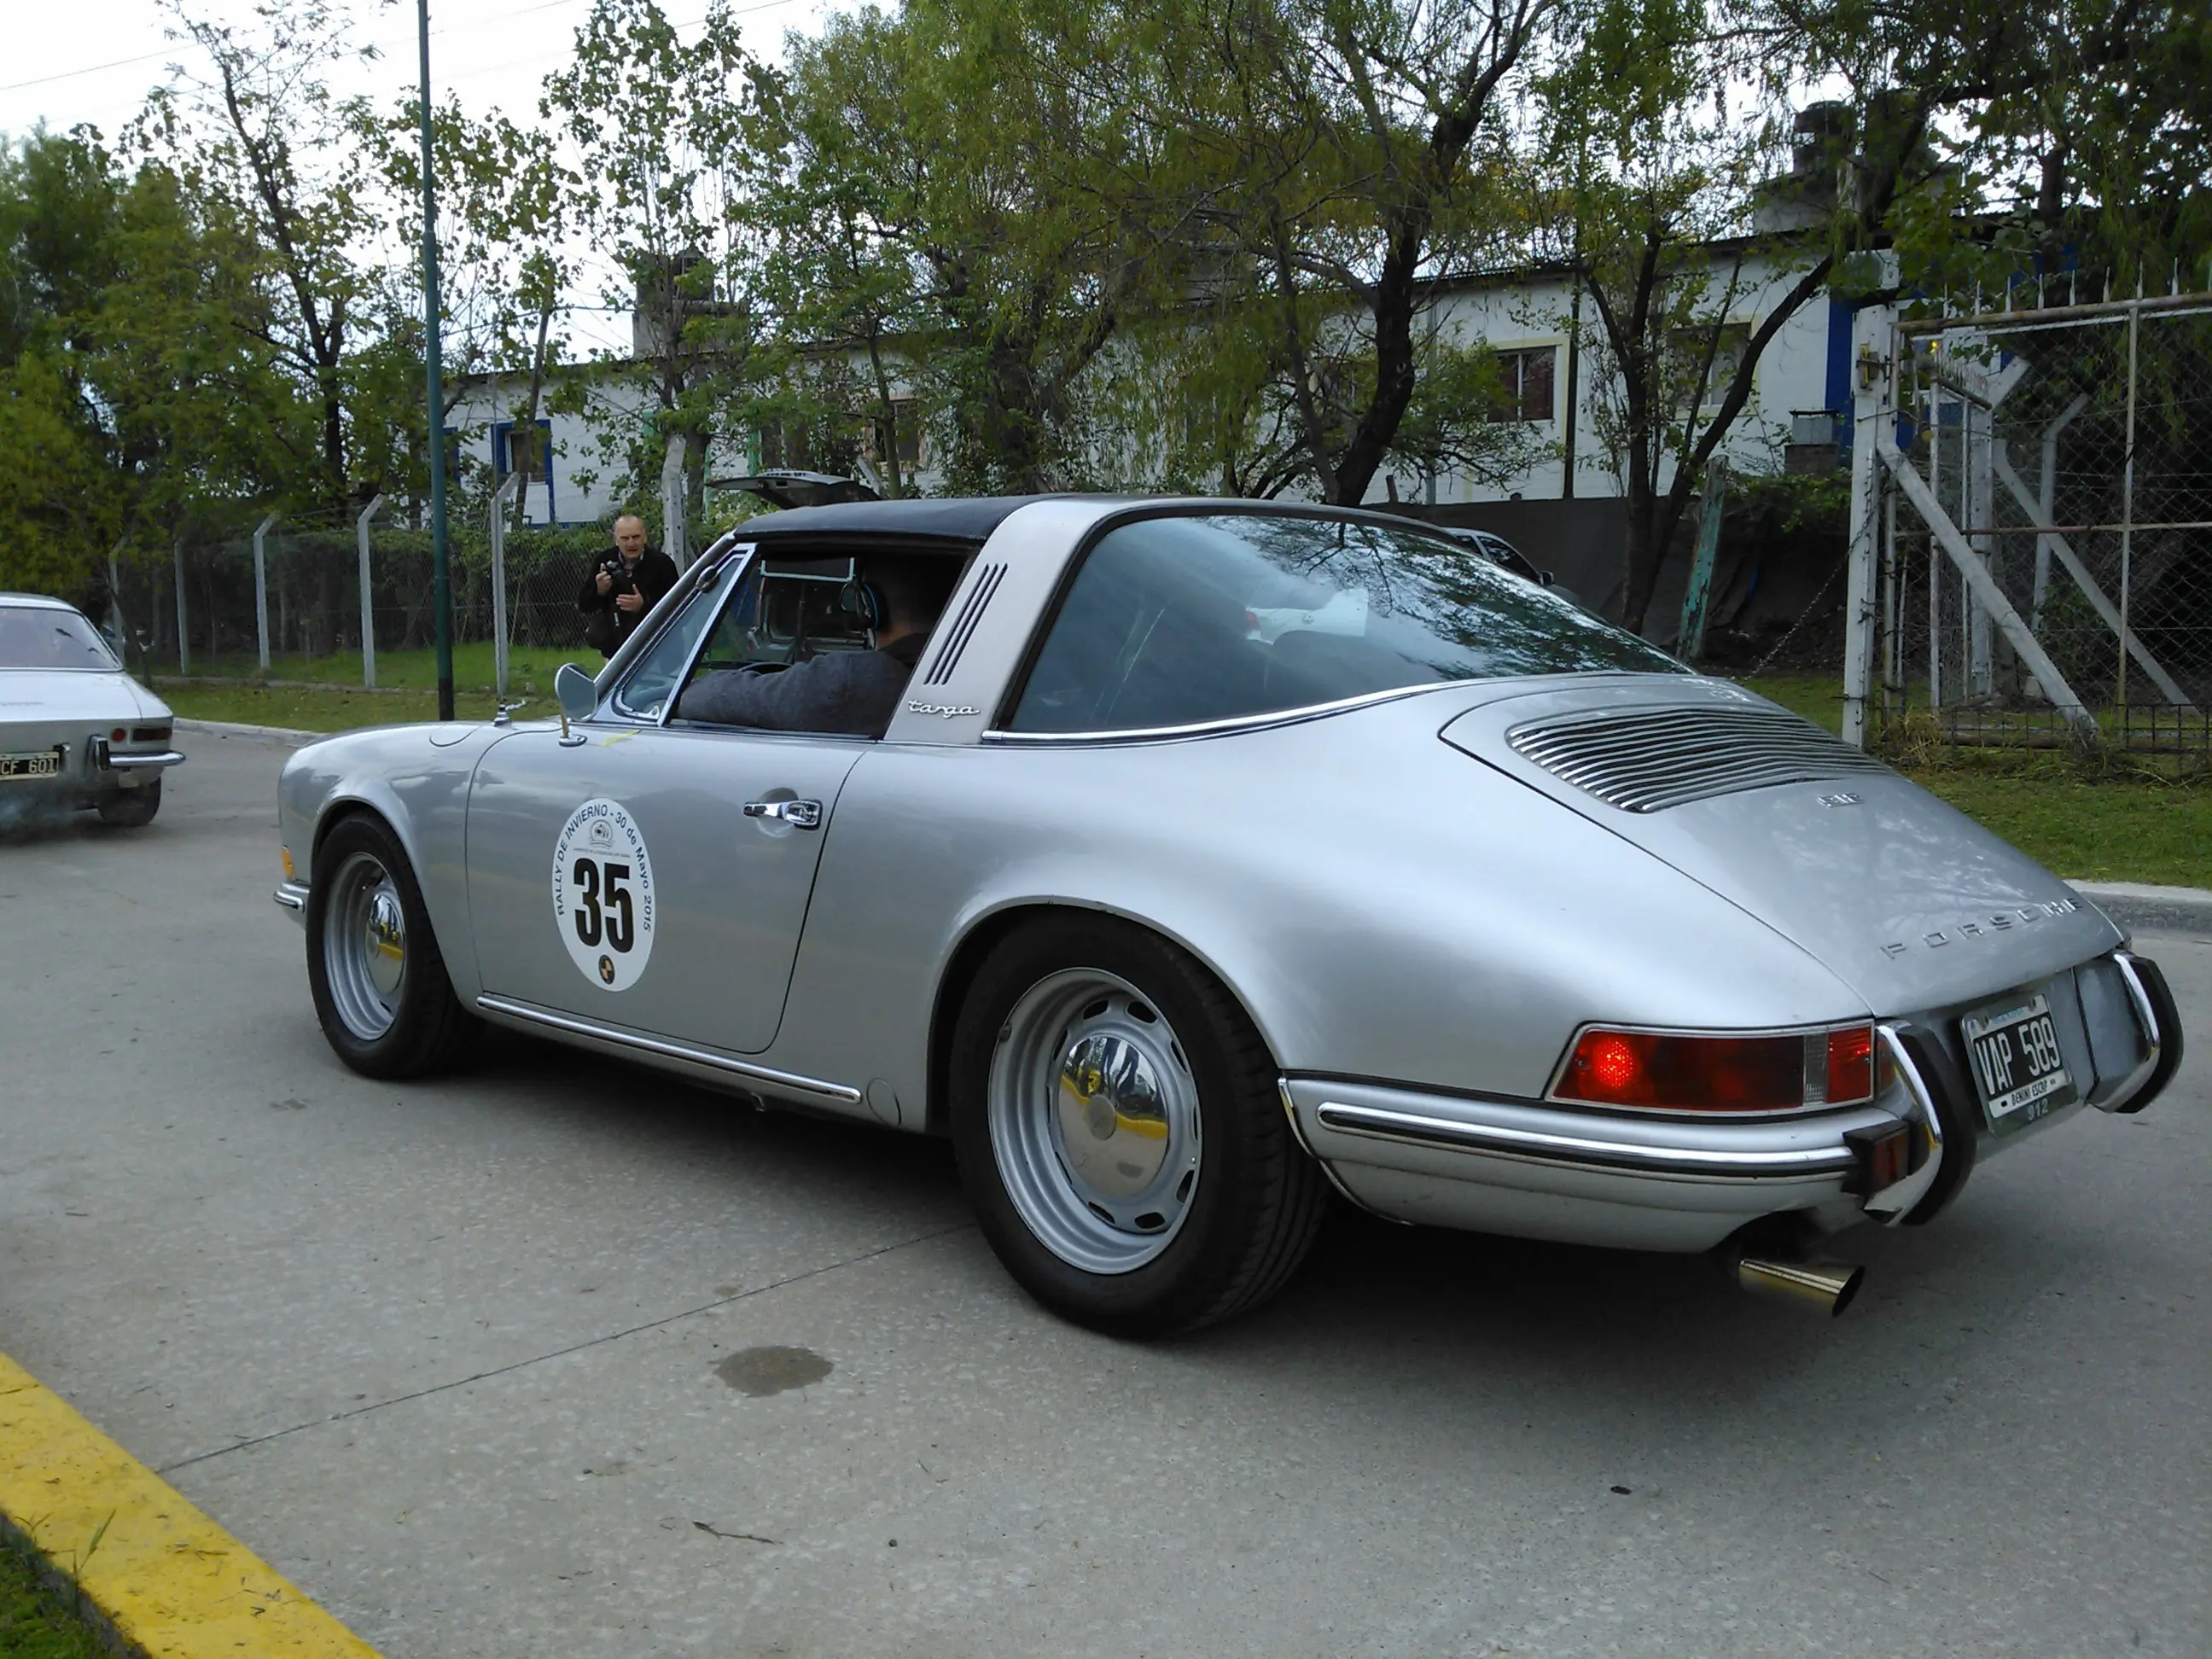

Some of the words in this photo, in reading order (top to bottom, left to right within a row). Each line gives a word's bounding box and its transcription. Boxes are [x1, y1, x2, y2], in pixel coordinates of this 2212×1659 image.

[908, 700, 980, 719] targa
[29, 760, 55, 773] 601
[566, 804, 608, 840] INVIERNO
[615, 812, 627, 829] 30
[626, 828, 637, 845] de
[557, 840, 568, 862] DE
[636, 847, 649, 889] Mayo
[555, 865, 565, 915] RALLY
[573, 858, 634, 953] 35
[643, 895, 652, 932] 2015
[1880, 898, 2083, 960] PORSCHE
[1976, 1033, 2013, 1095] VAP
[2018, 1016, 2060, 1076] 589
[2028, 1098, 2048, 1121] 912
